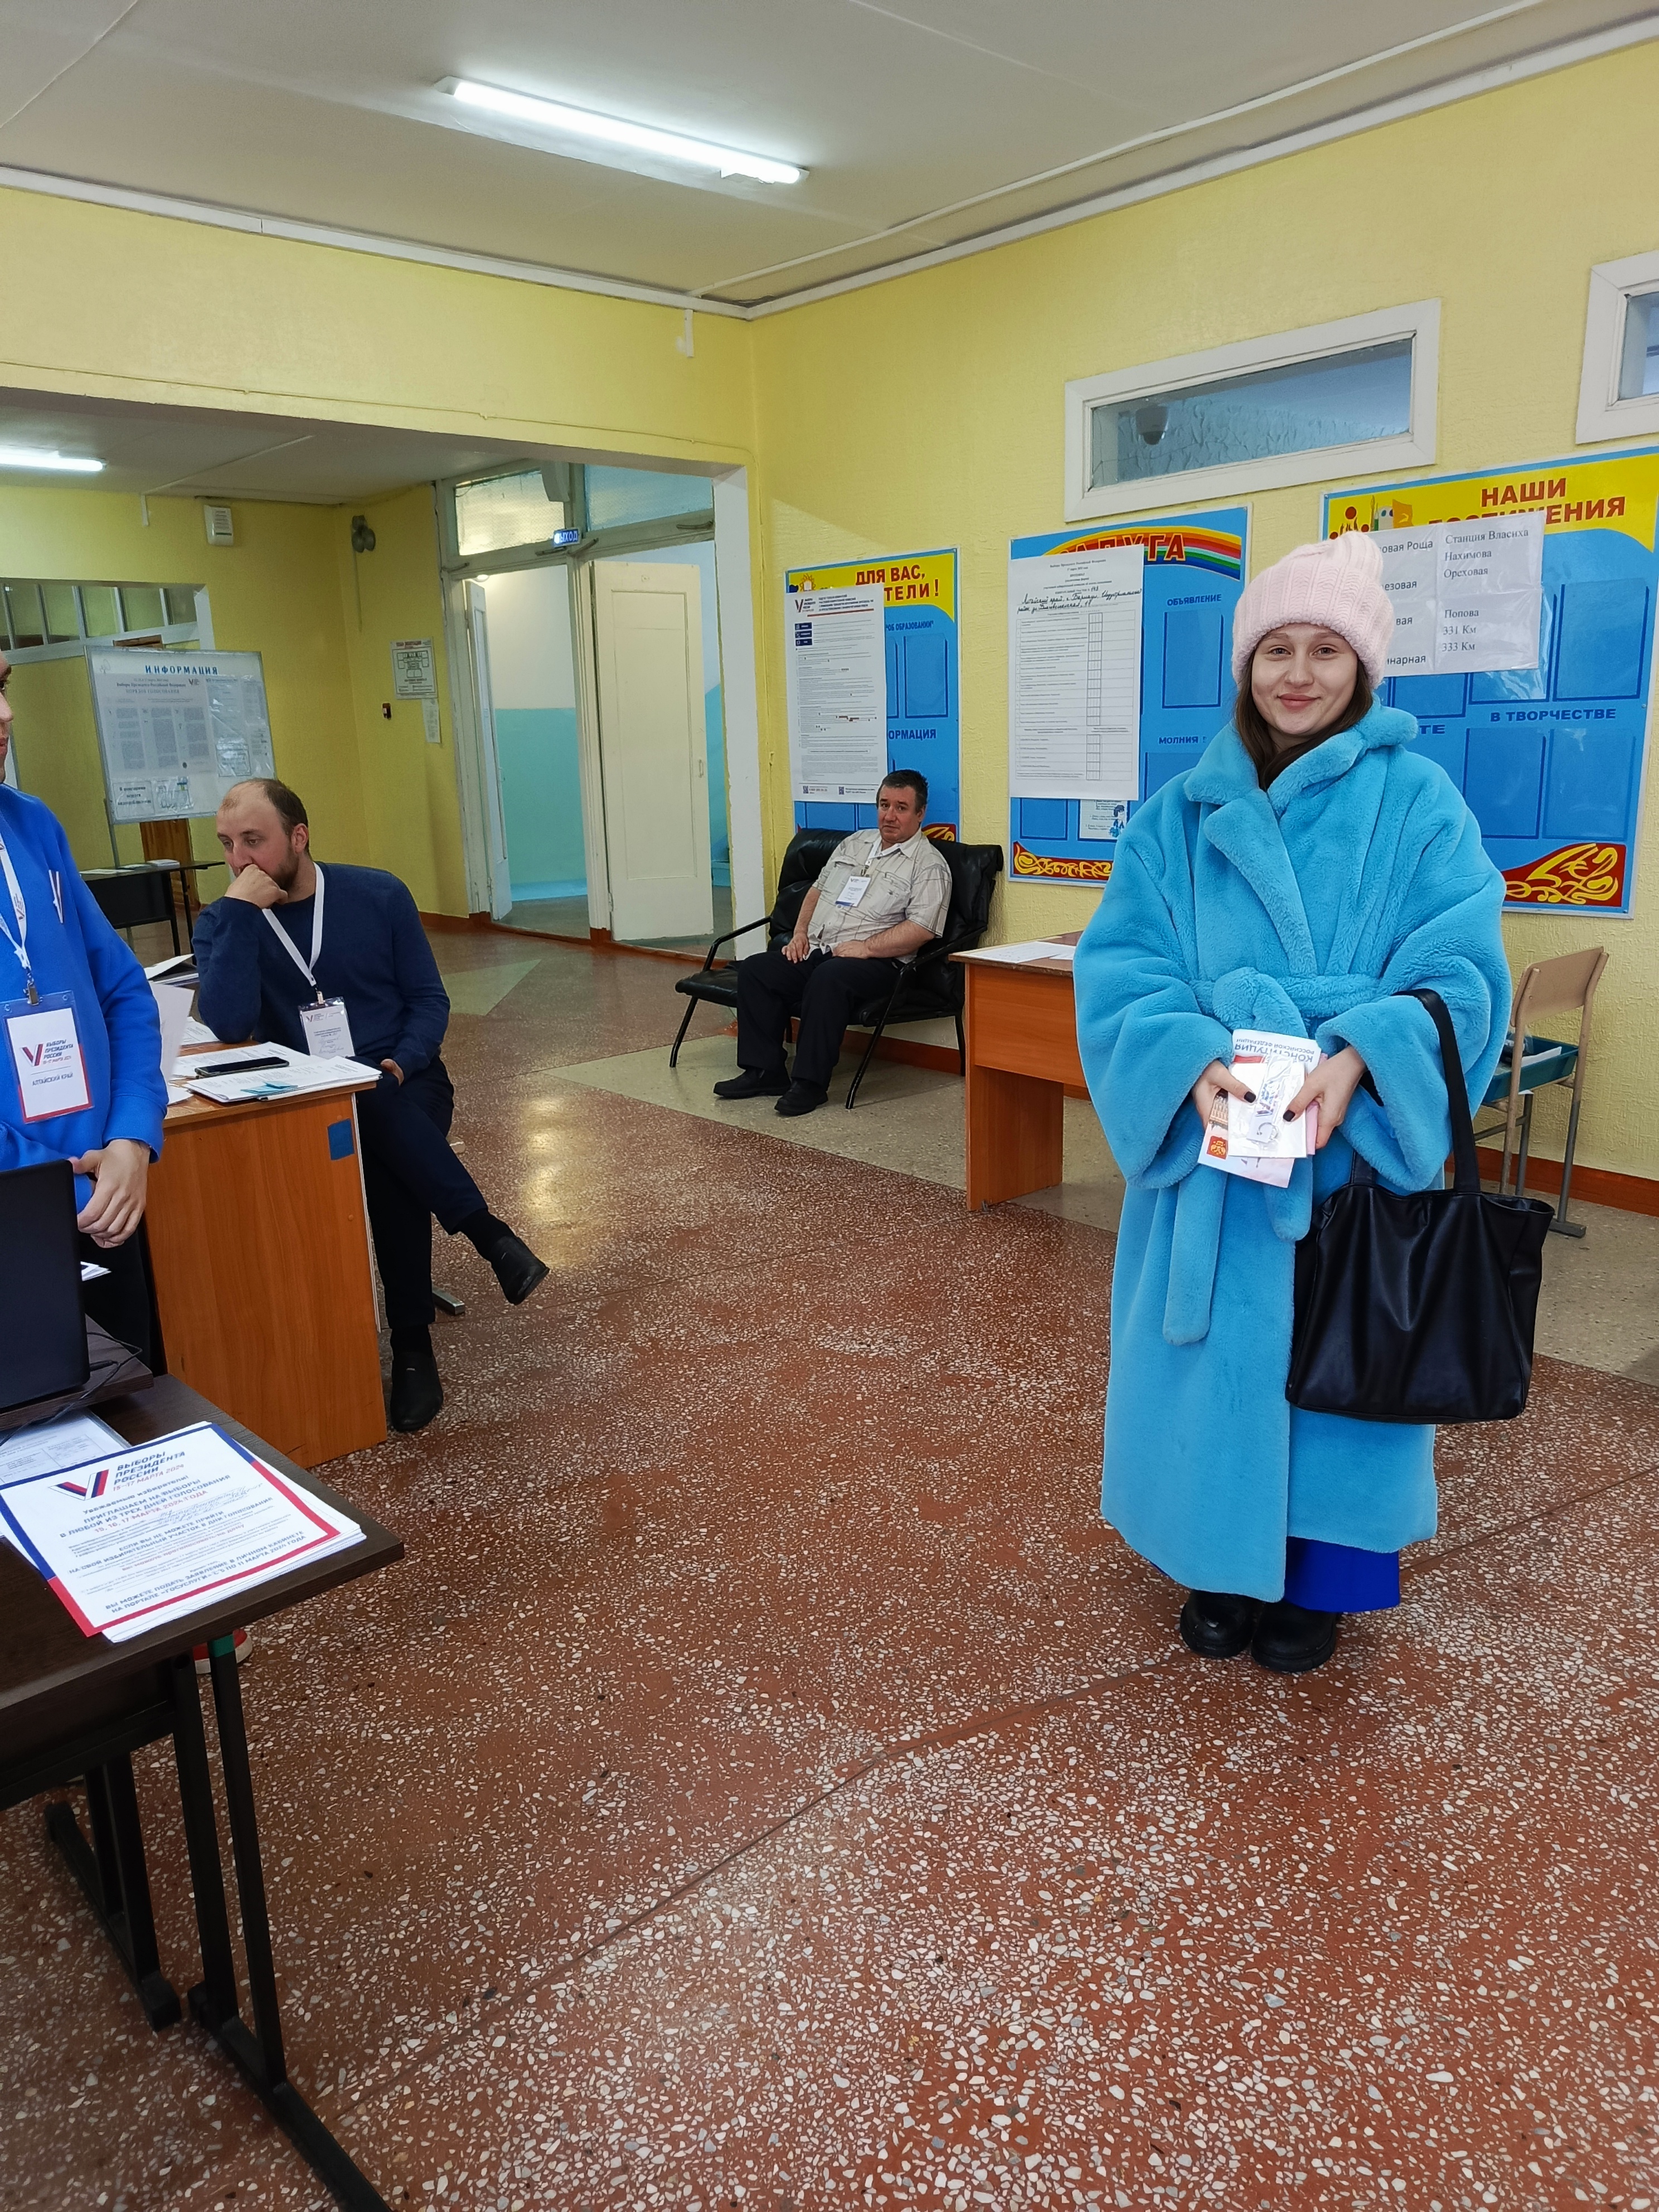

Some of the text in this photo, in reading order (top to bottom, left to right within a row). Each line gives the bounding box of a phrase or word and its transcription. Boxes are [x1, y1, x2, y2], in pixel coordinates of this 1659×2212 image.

[1481, 478, 1566, 508] НАШИ
[554, 531, 578, 544] ЫХОД
[1445, 529, 1529, 544] Станция Власиха
[1380, 541, 1433, 554] овая Роща
[1444, 550, 1492, 561] Нахимова
[856, 565, 925, 585] ДЛЯ ВАС,
[1444, 567, 1488, 580] Ореховая
[884, 583, 929, 601] ТЕЛИ
[1382, 581, 1417, 591] езовая
[1167, 593, 1221, 607] ОБЪЯВЛЕНИЕ
[1444, 609, 1479, 618] Попова
[1396, 617, 1413, 625] вая
[1443, 625, 1476, 635] 331 Км
[1442, 642, 1476, 652] 333 Км
[145, 665, 219, 675] ИНФОРМАЦИЯ
[1490, 709, 1616, 722] В ТВОРЧЕСТВЕ
[888, 729, 937, 741] ОРМАЦИЯ
[1419, 724, 1445, 734] ТЕ
[1158, 736, 1199, 744] МОЛНИЯ
[1273, 1043, 1314, 1055] РОССИЙСКОЙ
[115, 1451, 185, 1478] ПРЕЗИДЕНТА
[117, 1452, 166, 1471] ВЫБОРЫ
[114, 1467, 159, 1486] РОССИИ
[137, 1471, 164, 1483] МАРТА
[166, 1464, 185, 1474] 2024
[68, 1520, 103, 1535] ЛЮБОЙ
[105, 1517, 118, 1525] ИЗ
[119, 1507, 142, 1521] ТРЕХ
[144, 1496, 168, 1510] ДНЕЙ
[168, 1474, 231, 1501] ГОЛОСОВАНИЯ
[83, 1494, 135, 1515] Уважаемые
[84, 1498, 148, 1524] ПРИГЛАШАЕМ
[149, 1494, 161, 1502] НА
[162, 1479, 201, 1498] ВЫБОРЫ
[130, 1507, 162, 1520] МАРТА
[184, 1490, 208, 1501] ГОДА
[119, 1541, 139, 1551] ЕСЛИ
[164, 1521, 195, 1535] МОЖЕТЕ
[195, 1511, 224, 1524] ПРИЙТИ
[81, 1559, 103, 1570] СВОЙ
[169, 1524, 202, 1539] УЧАСТОК
[105, 1602, 119, 1610] ВЫ
[120, 1589, 153, 1604] МОЖЕТЕ
[154, 1578, 185, 1592] ПОДАТЬ
[185, 1561, 229, 1580] ЗАЯВЛЕНИЕ
[236, 1546, 268, 1561] ЛИЧНОМ
[268, 1530, 304, 1548] КАБИНЕТЕ
[124, 1593, 159, 1608] ПОРТАЛЕ
[245, 1551, 270, 1563] МАРТА
[287, 1535, 307, 1545] ГОДА
